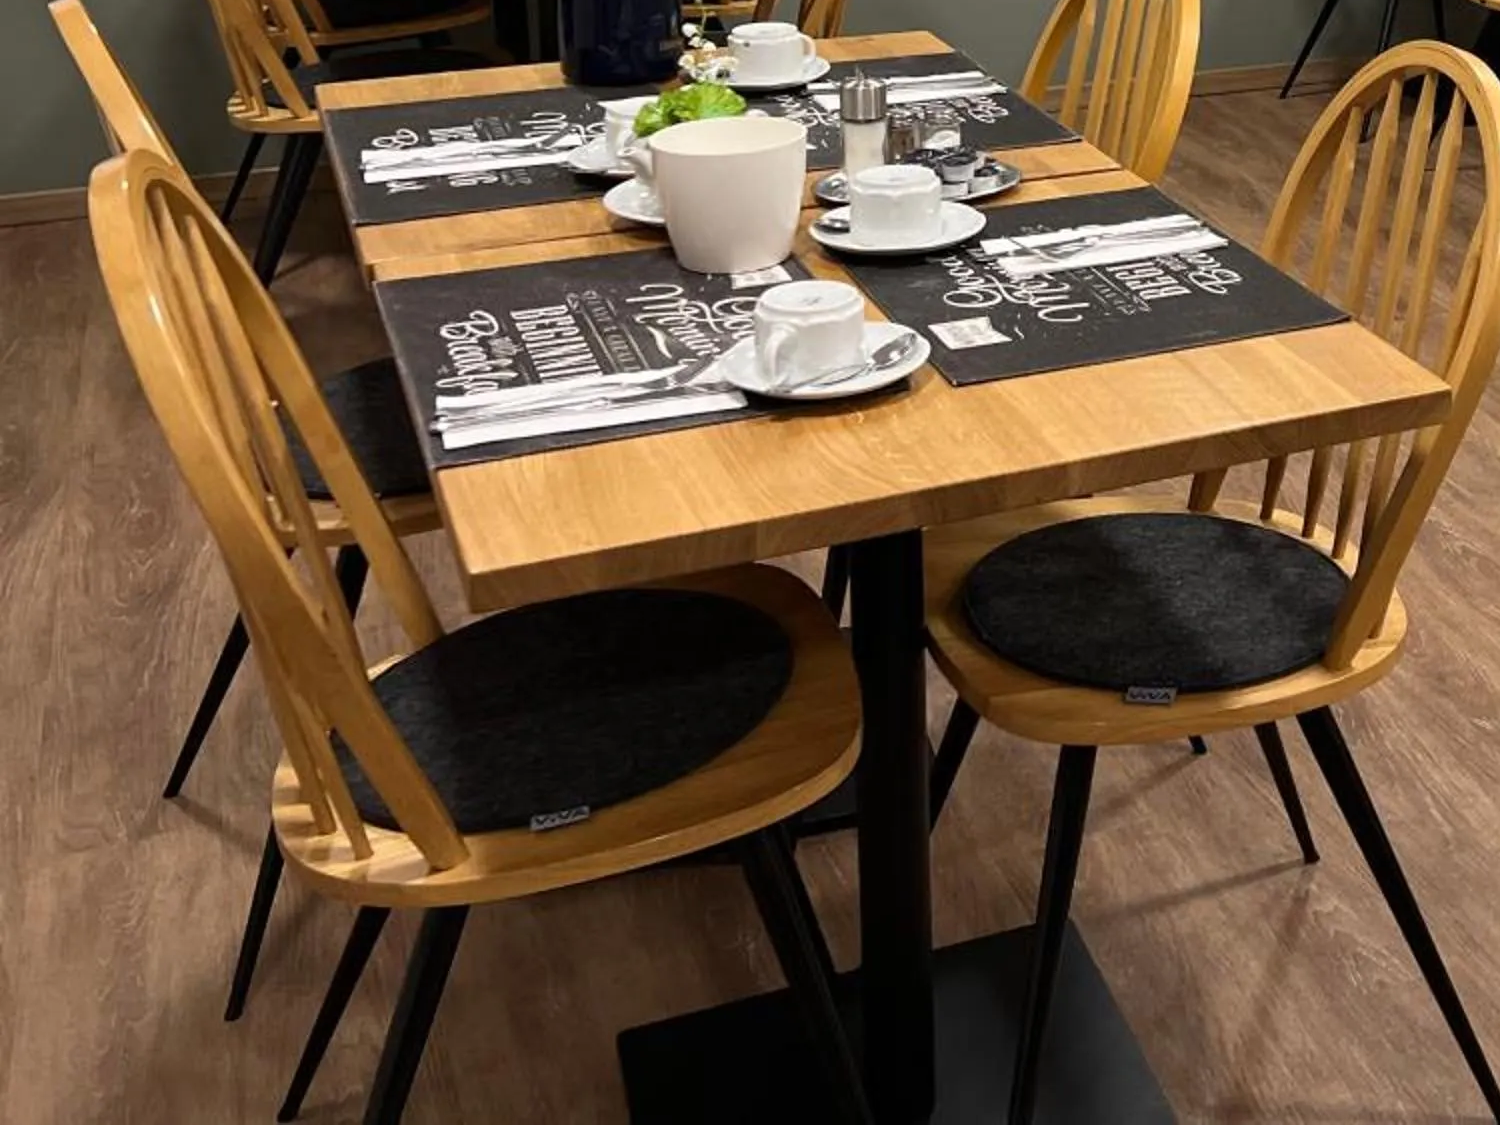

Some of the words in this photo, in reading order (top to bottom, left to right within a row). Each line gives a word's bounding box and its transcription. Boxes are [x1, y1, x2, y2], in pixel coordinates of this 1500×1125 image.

[435, 309, 520, 396] Breakfa
[510, 304, 603, 379] BEGINNI
[625, 282, 723, 367] Mornin
